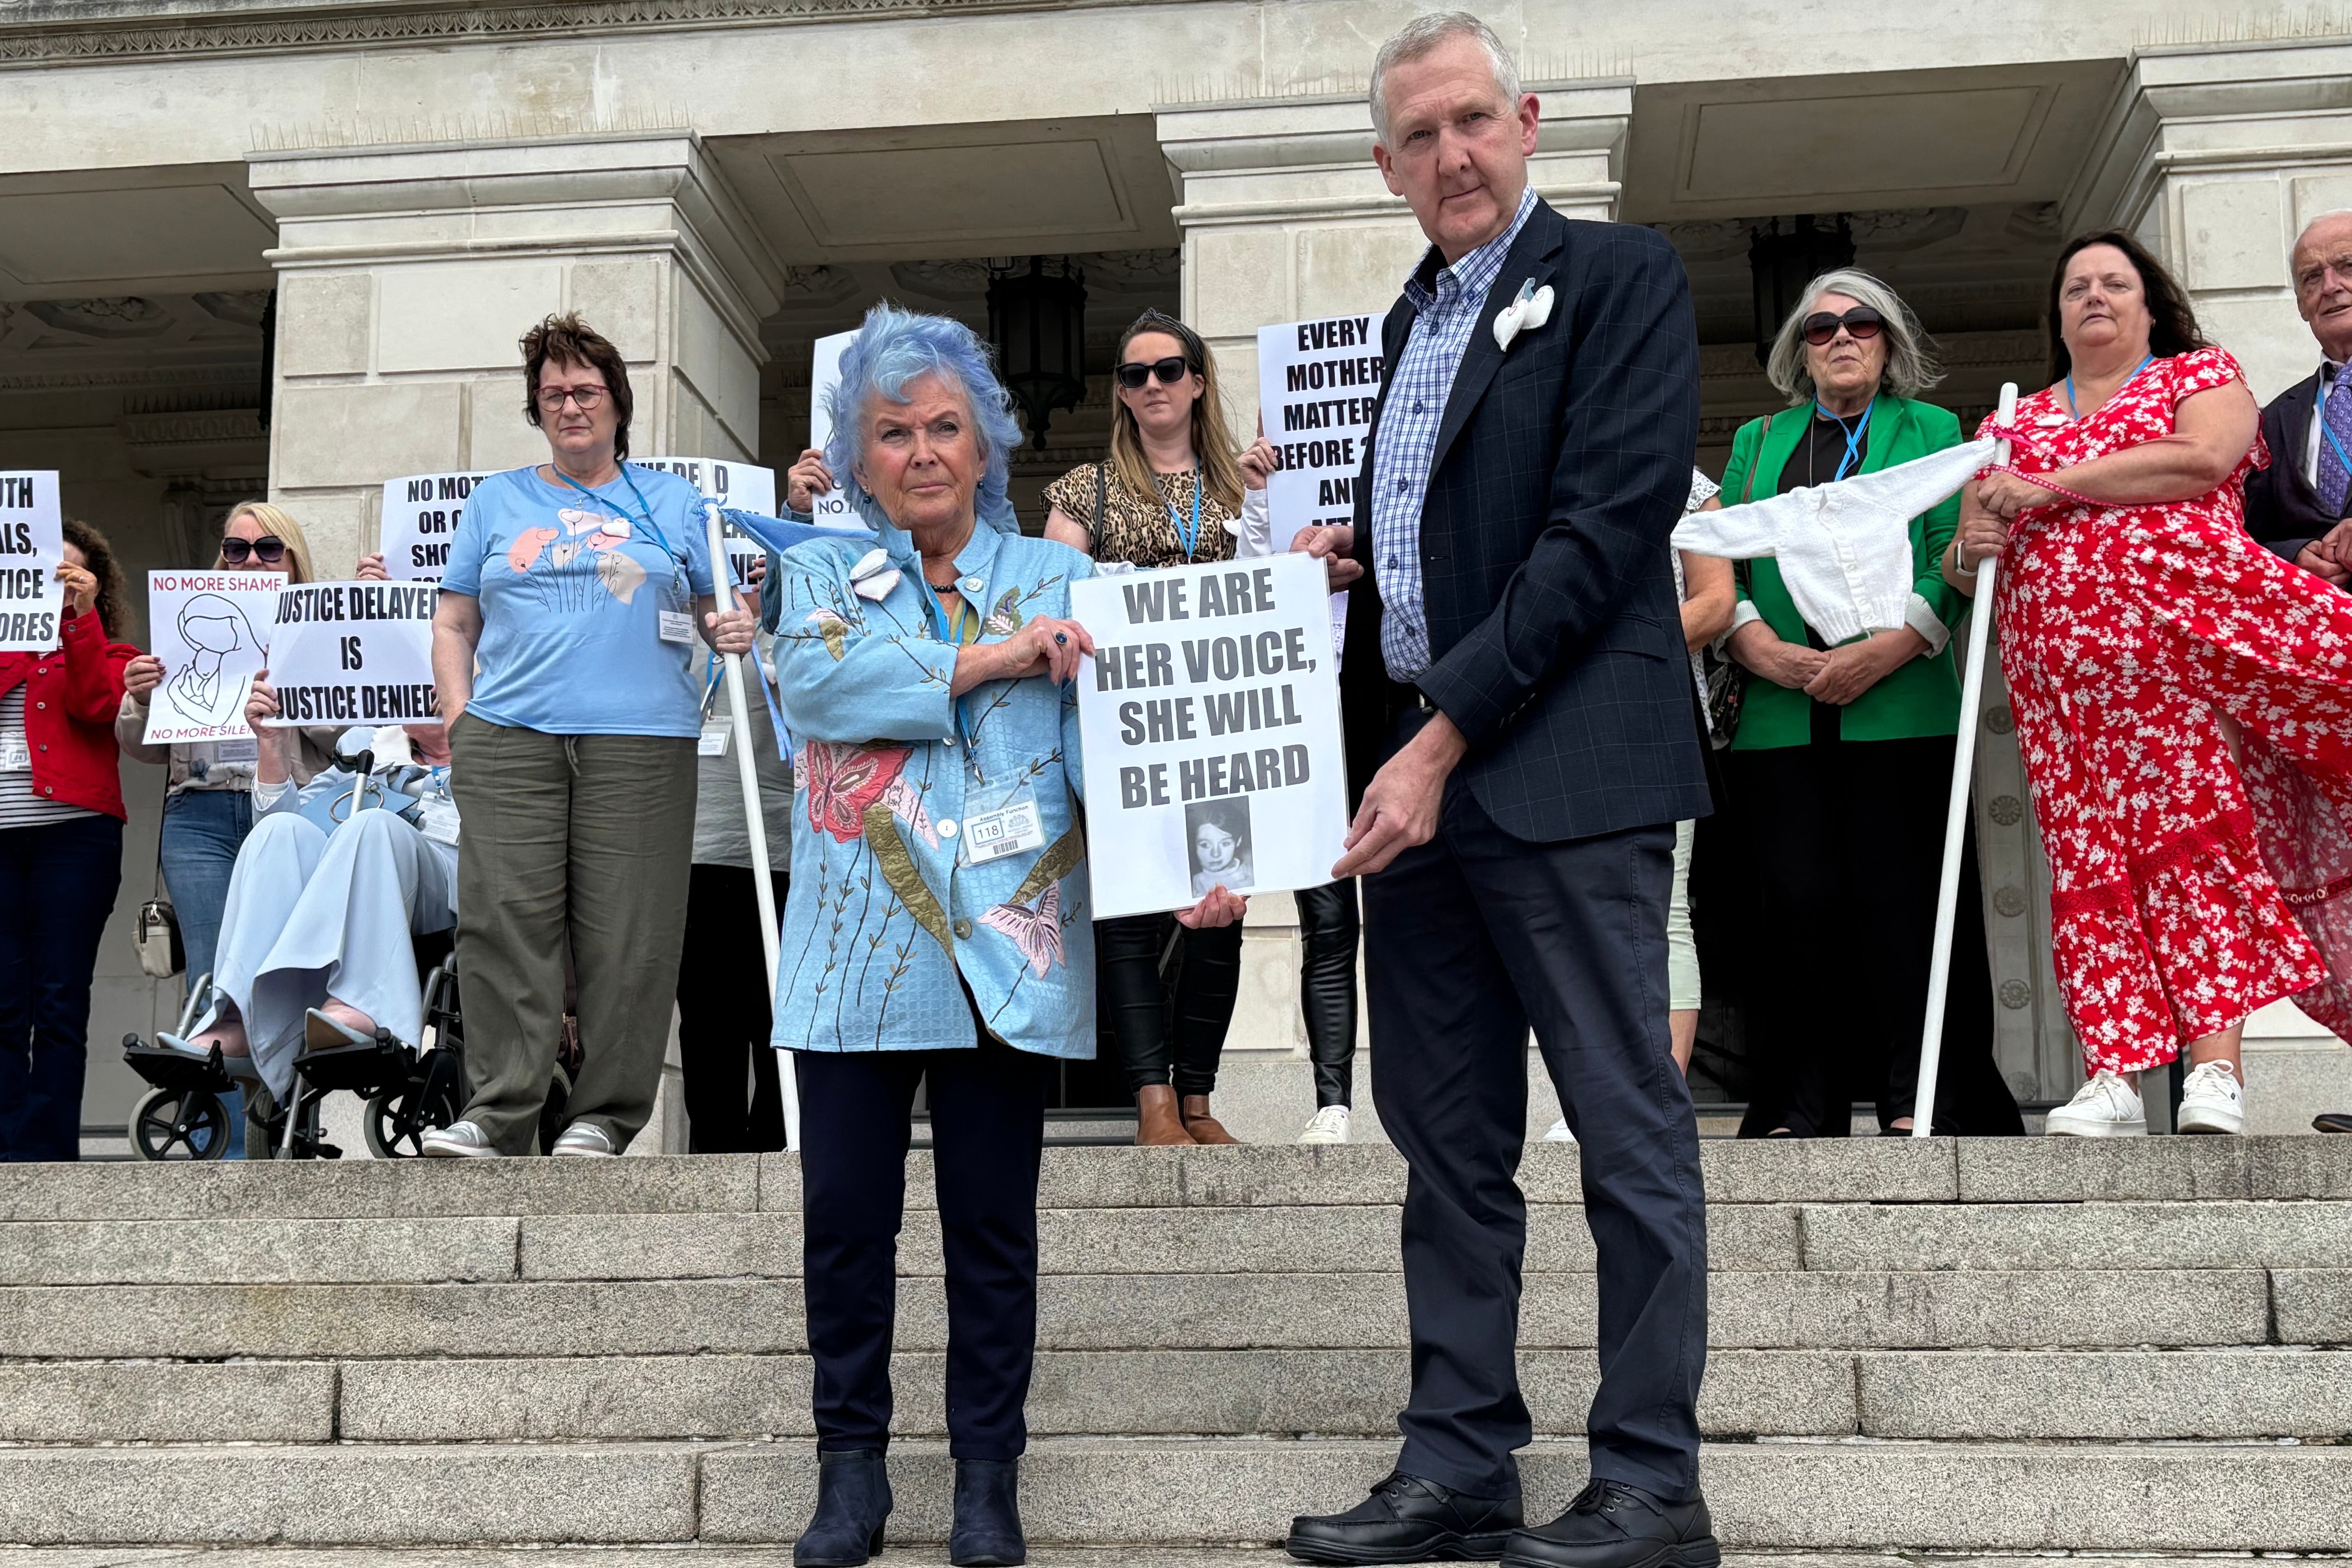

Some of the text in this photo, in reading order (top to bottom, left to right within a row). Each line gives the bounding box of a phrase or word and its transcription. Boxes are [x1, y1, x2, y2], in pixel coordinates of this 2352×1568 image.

[1298, 317, 1370, 351] EVERY
[1287, 356, 1386, 392] MOTHER
[1271, 438, 1355, 471] BEFORE
[408, 476, 488, 502] NO MOT
[419, 511, 446, 534] OR
[818, 499, 844, 514] NO
[154, 577, 177, 591] NO
[181, 577, 225, 591] MORE
[1122, 568, 1276, 624] WE ARE
[275, 588, 345, 624] JUSTICE
[341, 636, 363, 670] IS
[1095, 627, 1316, 692] HER VOICE,
[276, 684, 436, 720] JUSTICE DENIED
[1119, 684, 1302, 746] SHE WILL
[151, 729, 173, 740] NO
[176, 726, 216, 739] MORE
[1120, 744, 1310, 810] BE HEARD
[980, 805, 1028, 821] Assembly Function
[978, 825, 999, 838] 118
